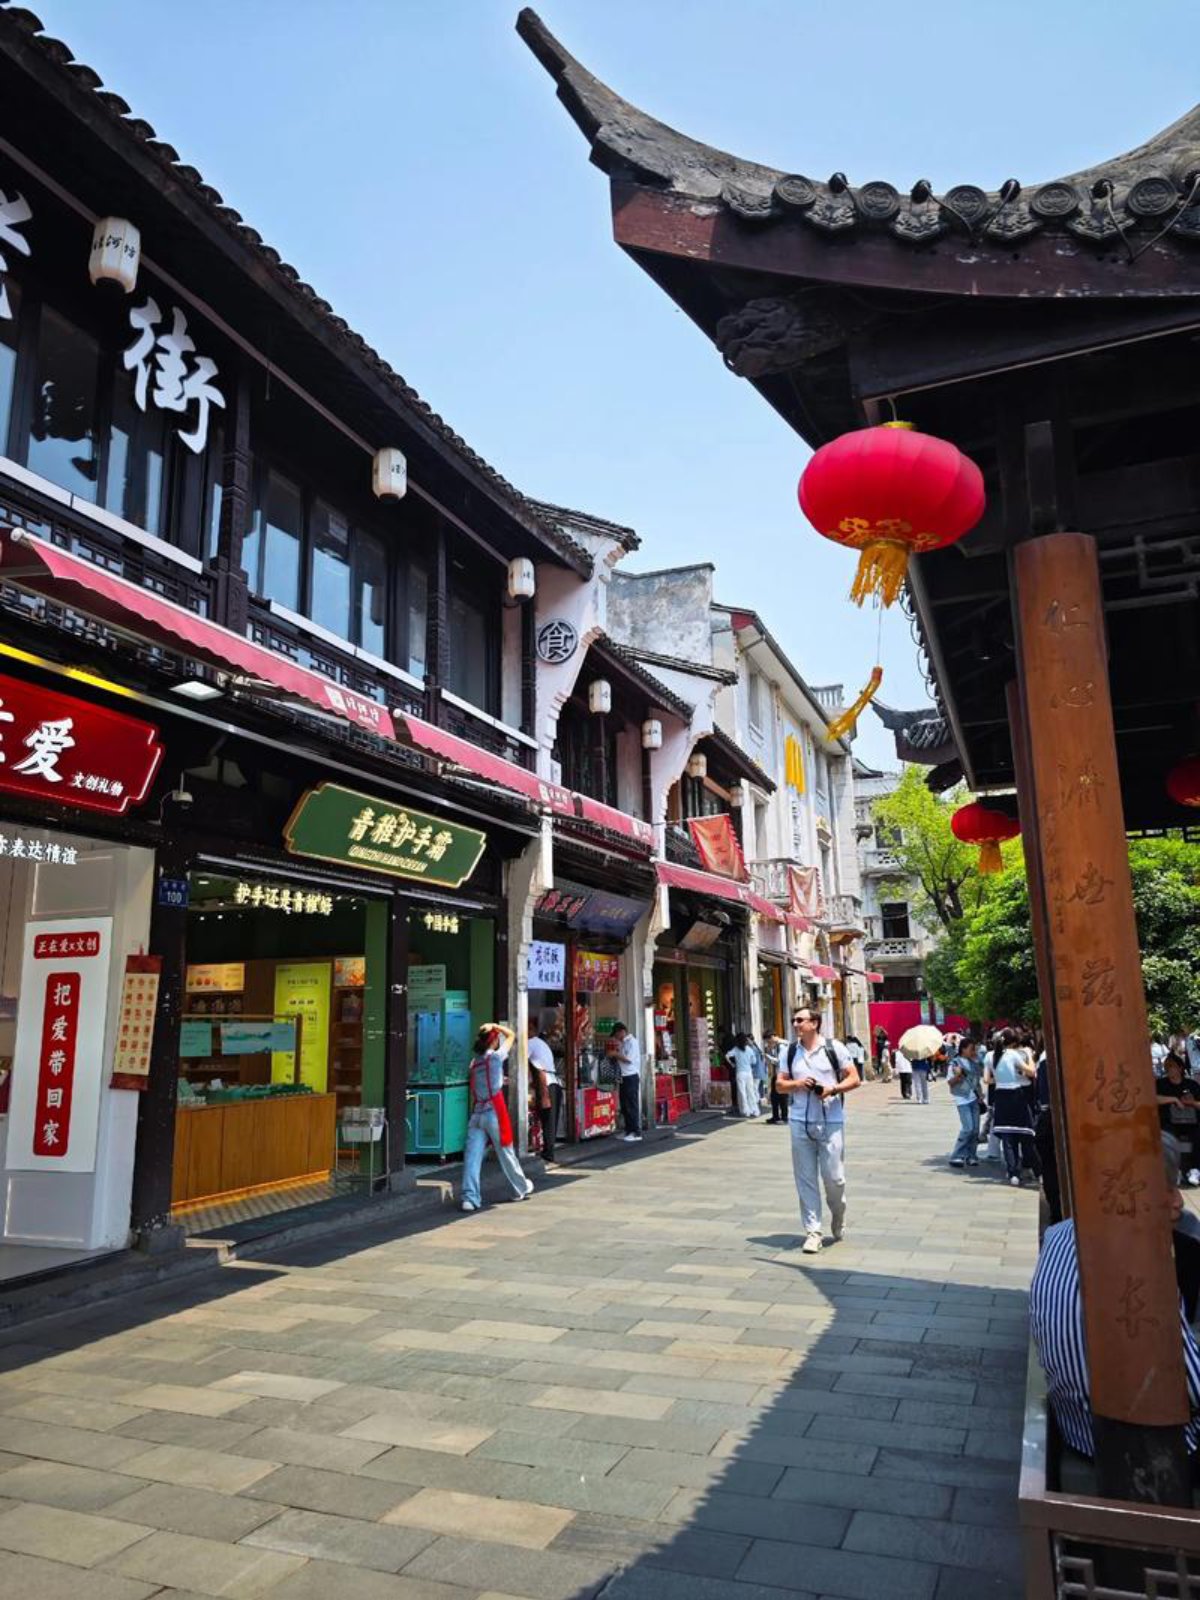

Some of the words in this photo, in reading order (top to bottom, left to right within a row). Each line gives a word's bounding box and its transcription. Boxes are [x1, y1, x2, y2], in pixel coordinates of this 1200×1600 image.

[71, 772, 125, 797] 文创礼物
[43, 982, 71, 1146] 把爱带回家
